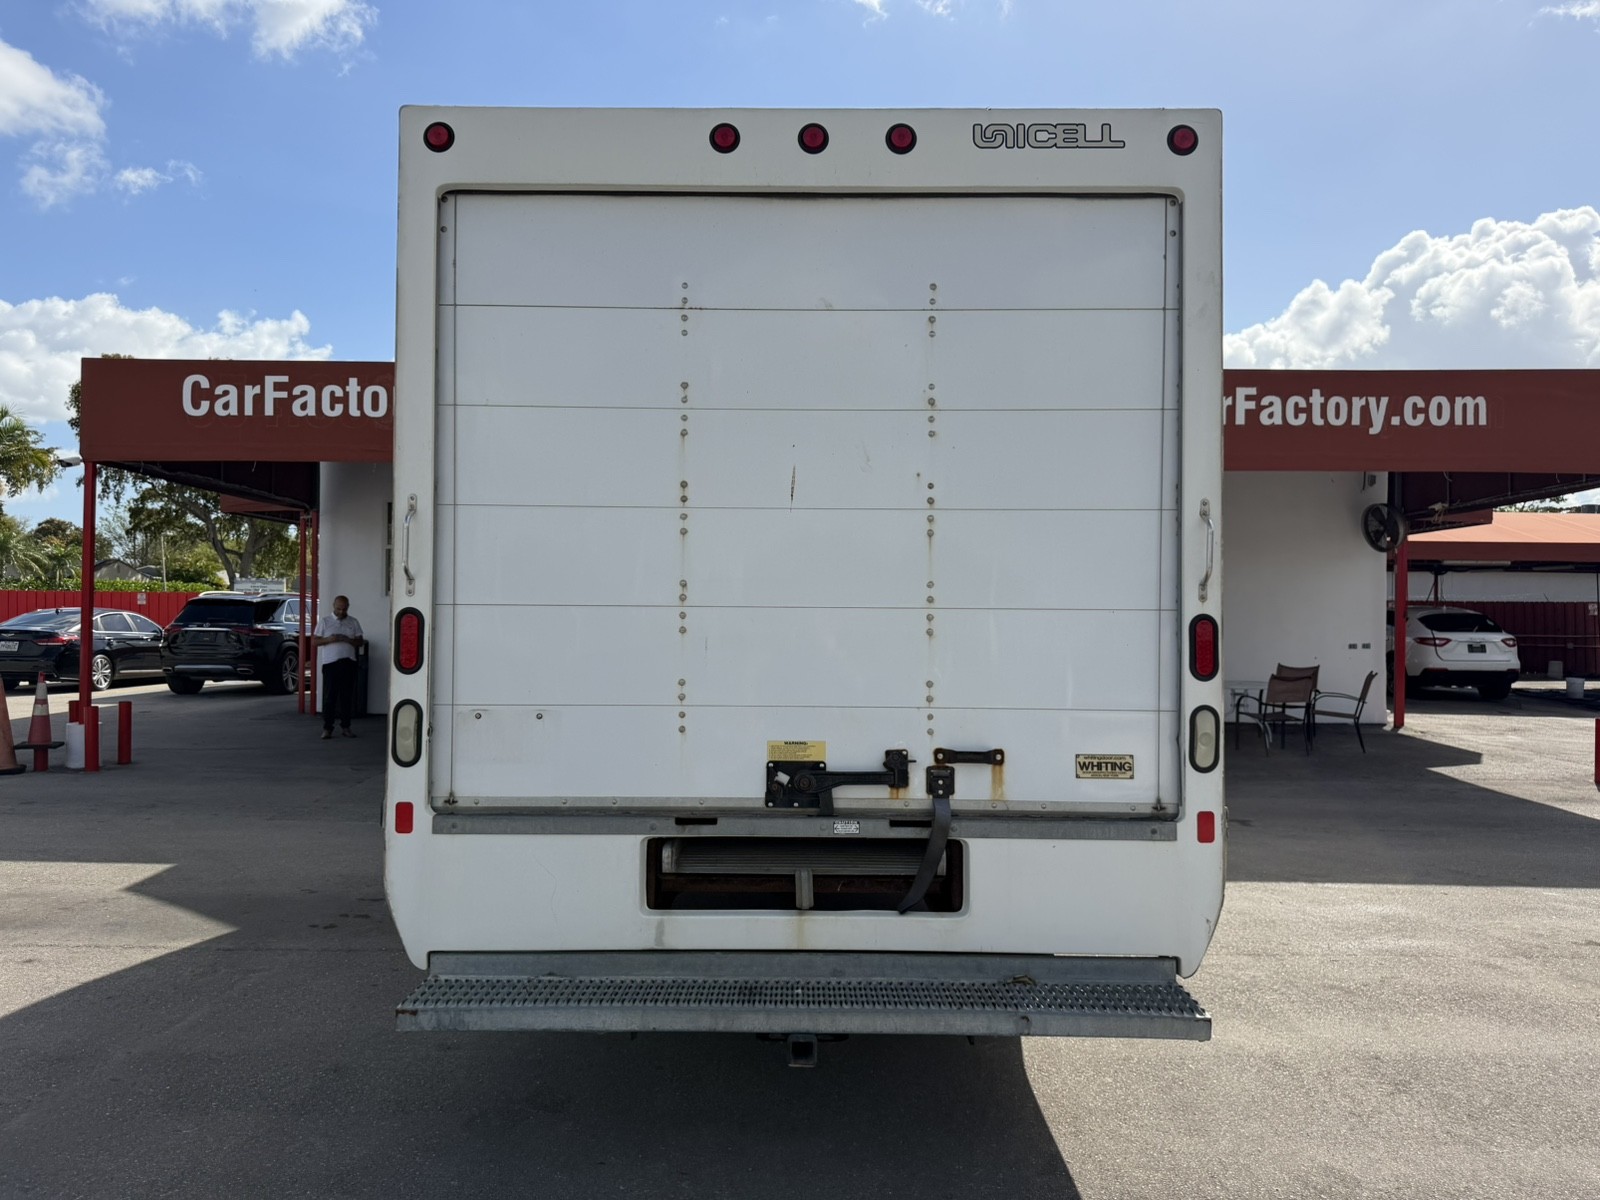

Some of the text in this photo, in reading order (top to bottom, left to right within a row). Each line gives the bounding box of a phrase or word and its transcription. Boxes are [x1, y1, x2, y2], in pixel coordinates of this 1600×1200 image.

[973, 123, 1126, 149] UNICELL
[182, 374, 395, 418] CarFacto
[1077, 761, 1132, 772] WHITING
